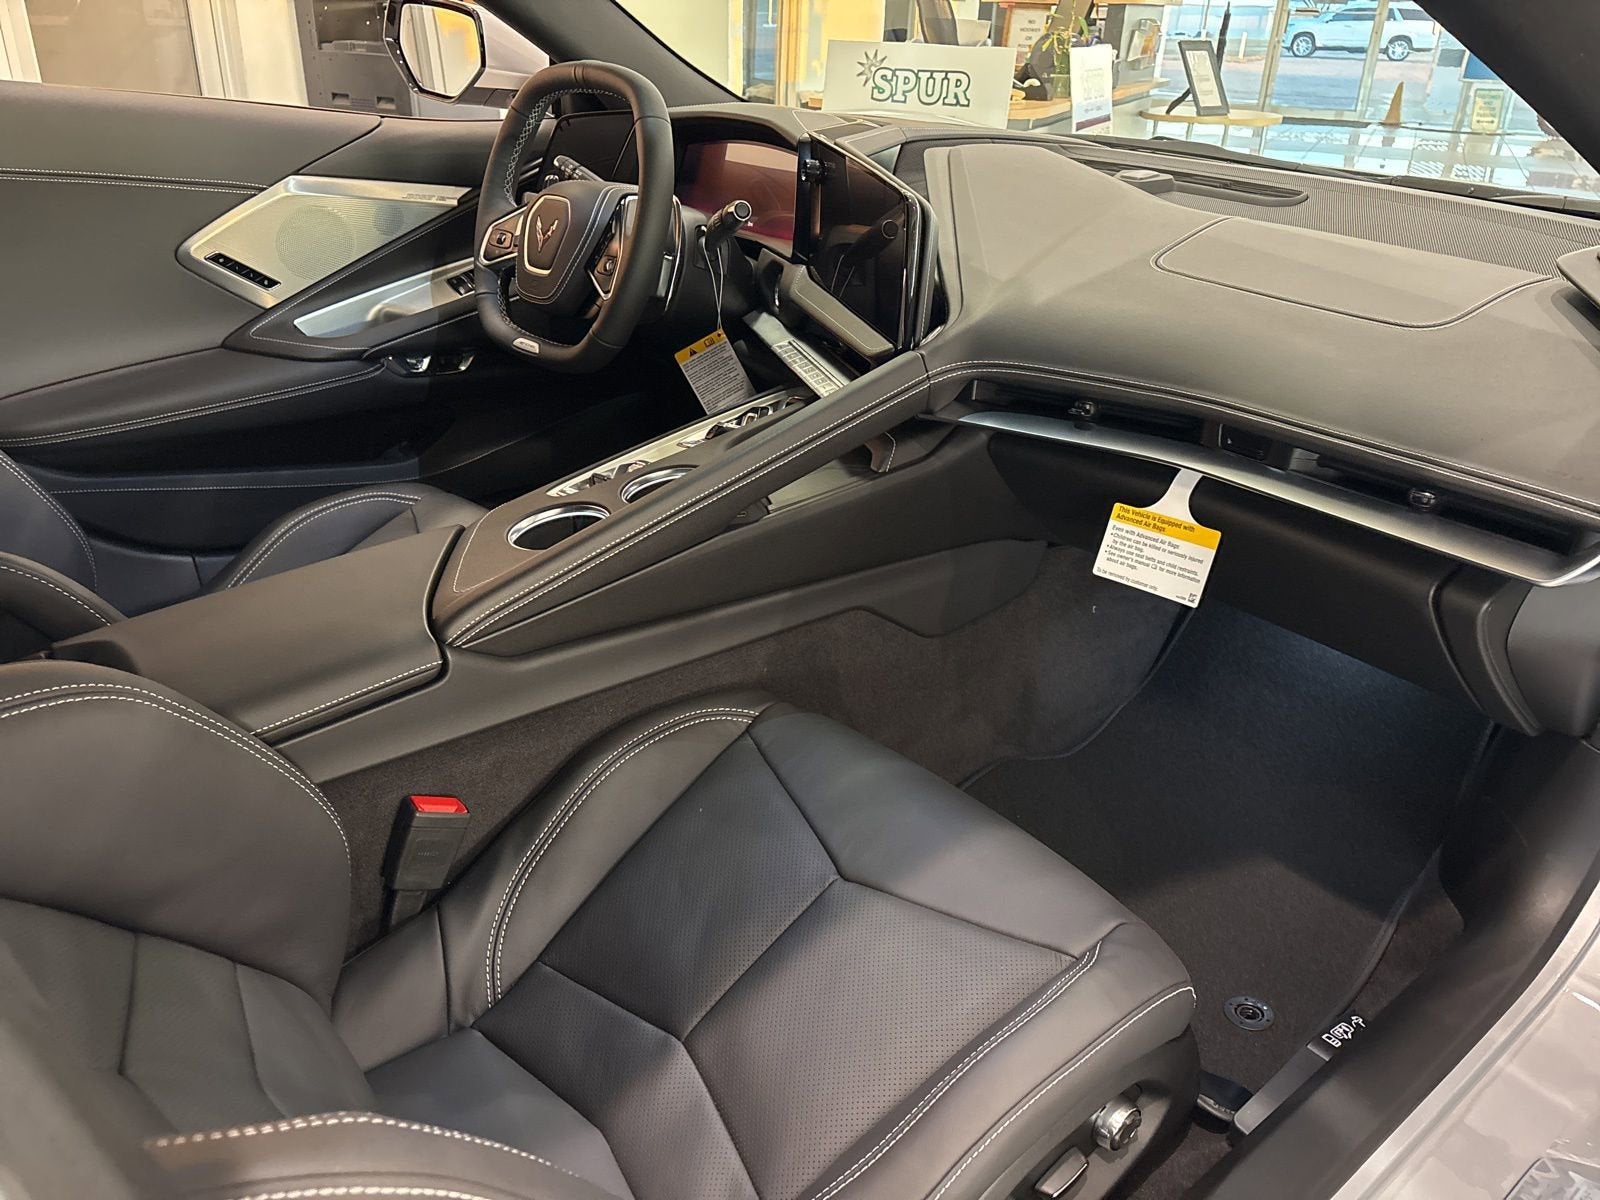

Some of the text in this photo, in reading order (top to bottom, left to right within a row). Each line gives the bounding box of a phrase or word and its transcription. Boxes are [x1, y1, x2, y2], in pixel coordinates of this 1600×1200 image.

[871, 66, 971, 107] SPUR
[1116, 513, 1143, 525] Advanced
[1152, 523, 1166, 532] Bags
[1119, 506, 1130, 514] This
[1132, 510, 1150, 520] Vehicle
[1157, 517, 1182, 528] Equipped
[1113, 533, 1132, 542] Children
[1168, 550, 1187, 560] seriously
[1188, 556, 1204, 564] injured
[1136, 532, 1159, 543] Advanced
[1167, 541, 1180, 549] Bags
